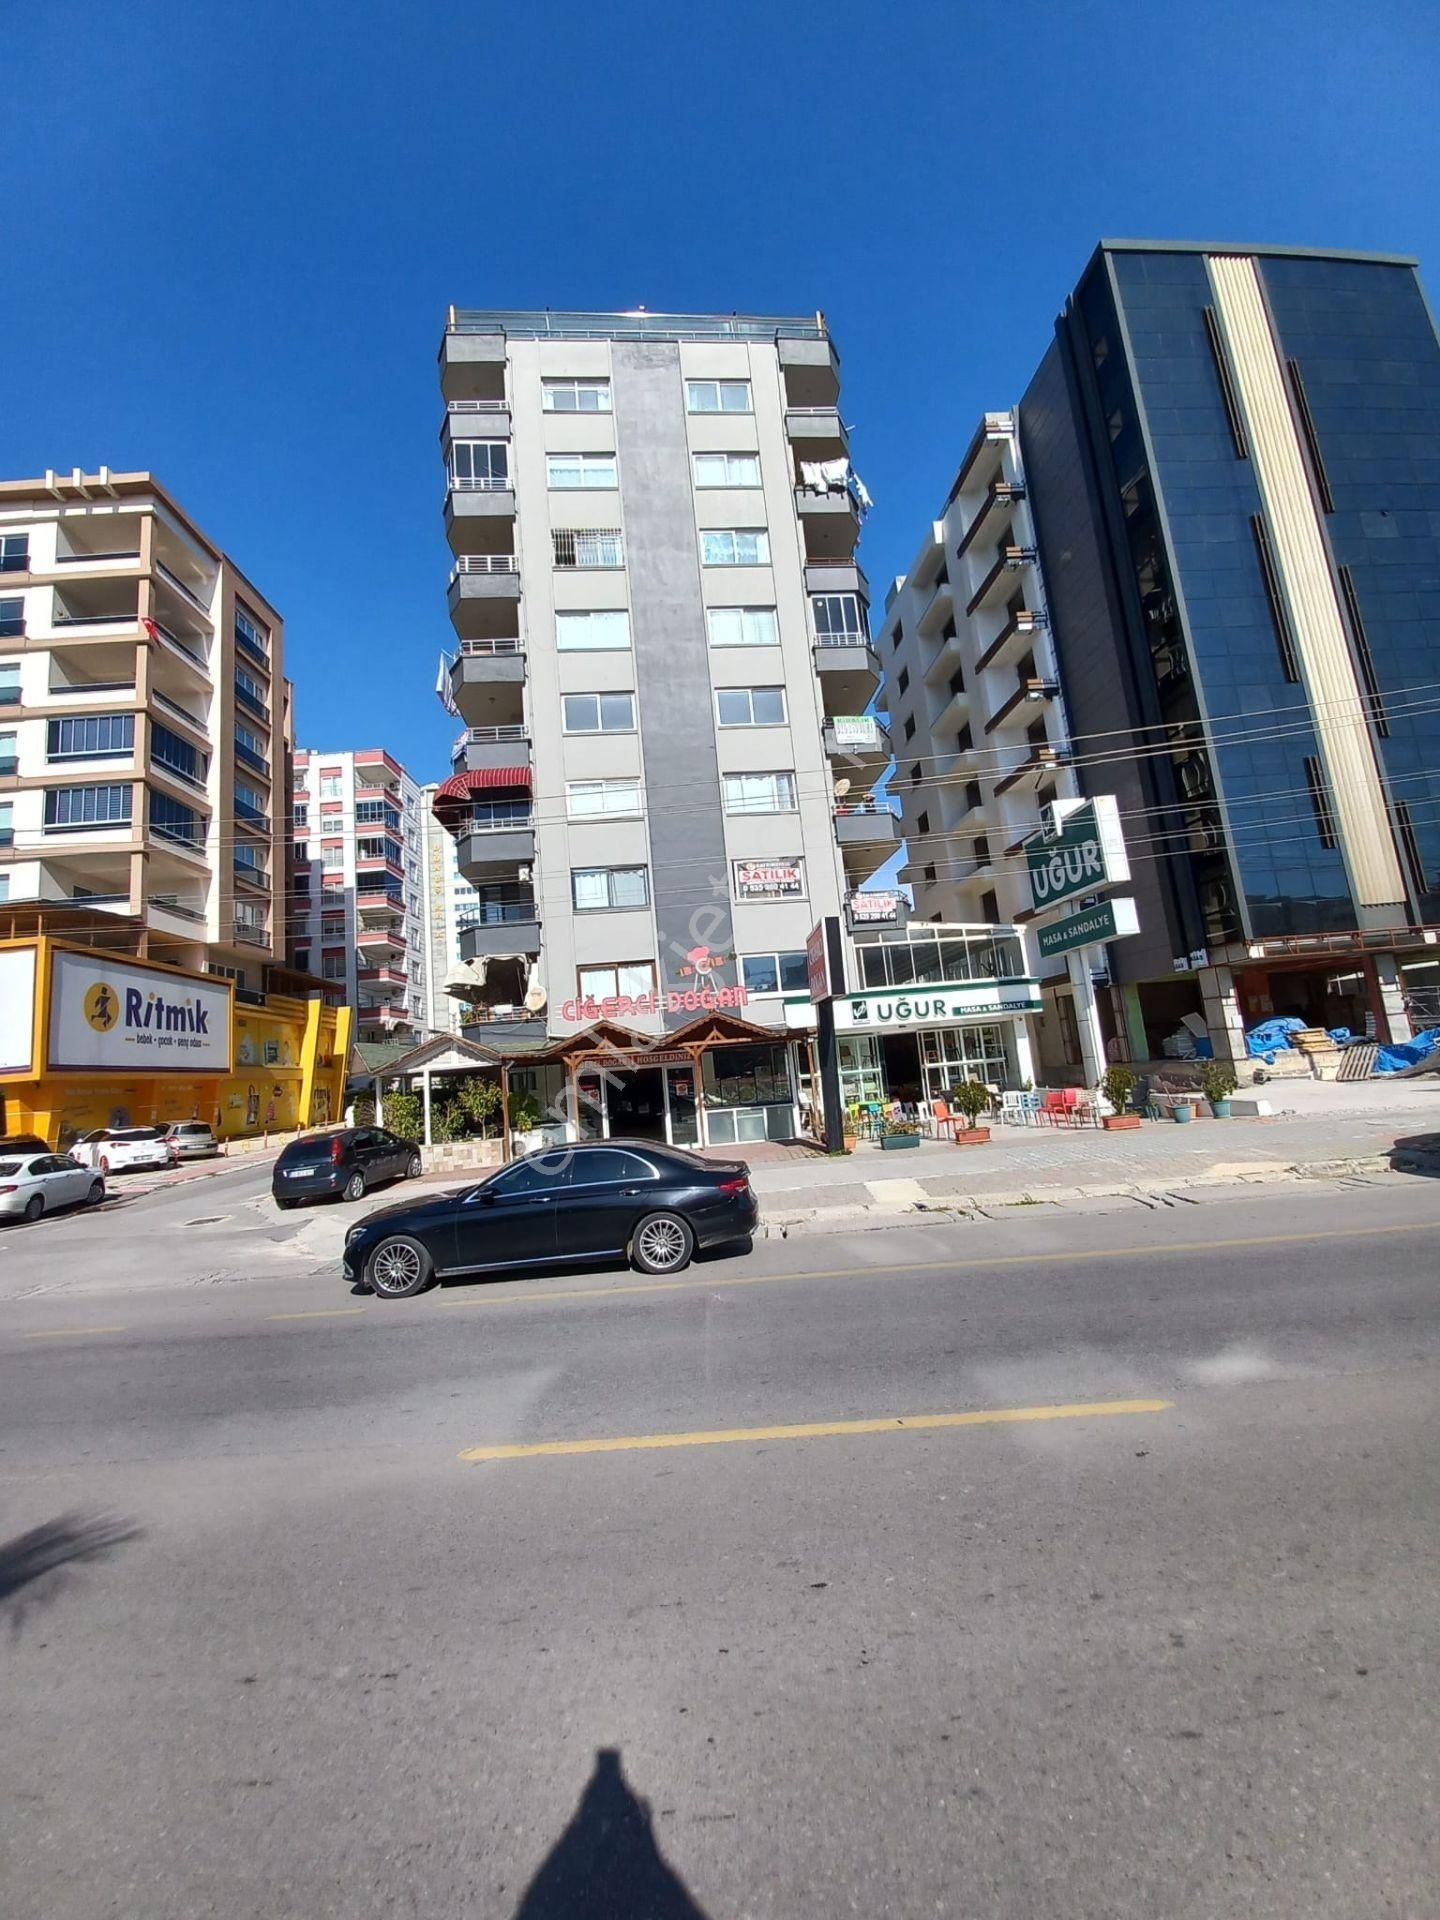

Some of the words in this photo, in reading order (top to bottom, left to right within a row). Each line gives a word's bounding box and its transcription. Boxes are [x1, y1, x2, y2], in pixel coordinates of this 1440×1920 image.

[742, 869, 797, 881] SATILIK
[1033, 839, 1102, 899] UĞUR
[853, 899, 895, 910] SATILIK
[1042, 931, 1063, 947] MASA
[1067, 914, 1110, 937] SANDALYE
[125, 987, 208, 1034] Ritmik
[877, 997, 947, 1021] UĞUR
[961, 1006, 982, 1014] MASA
[988, 1002, 1025, 1011] SANDALYE
